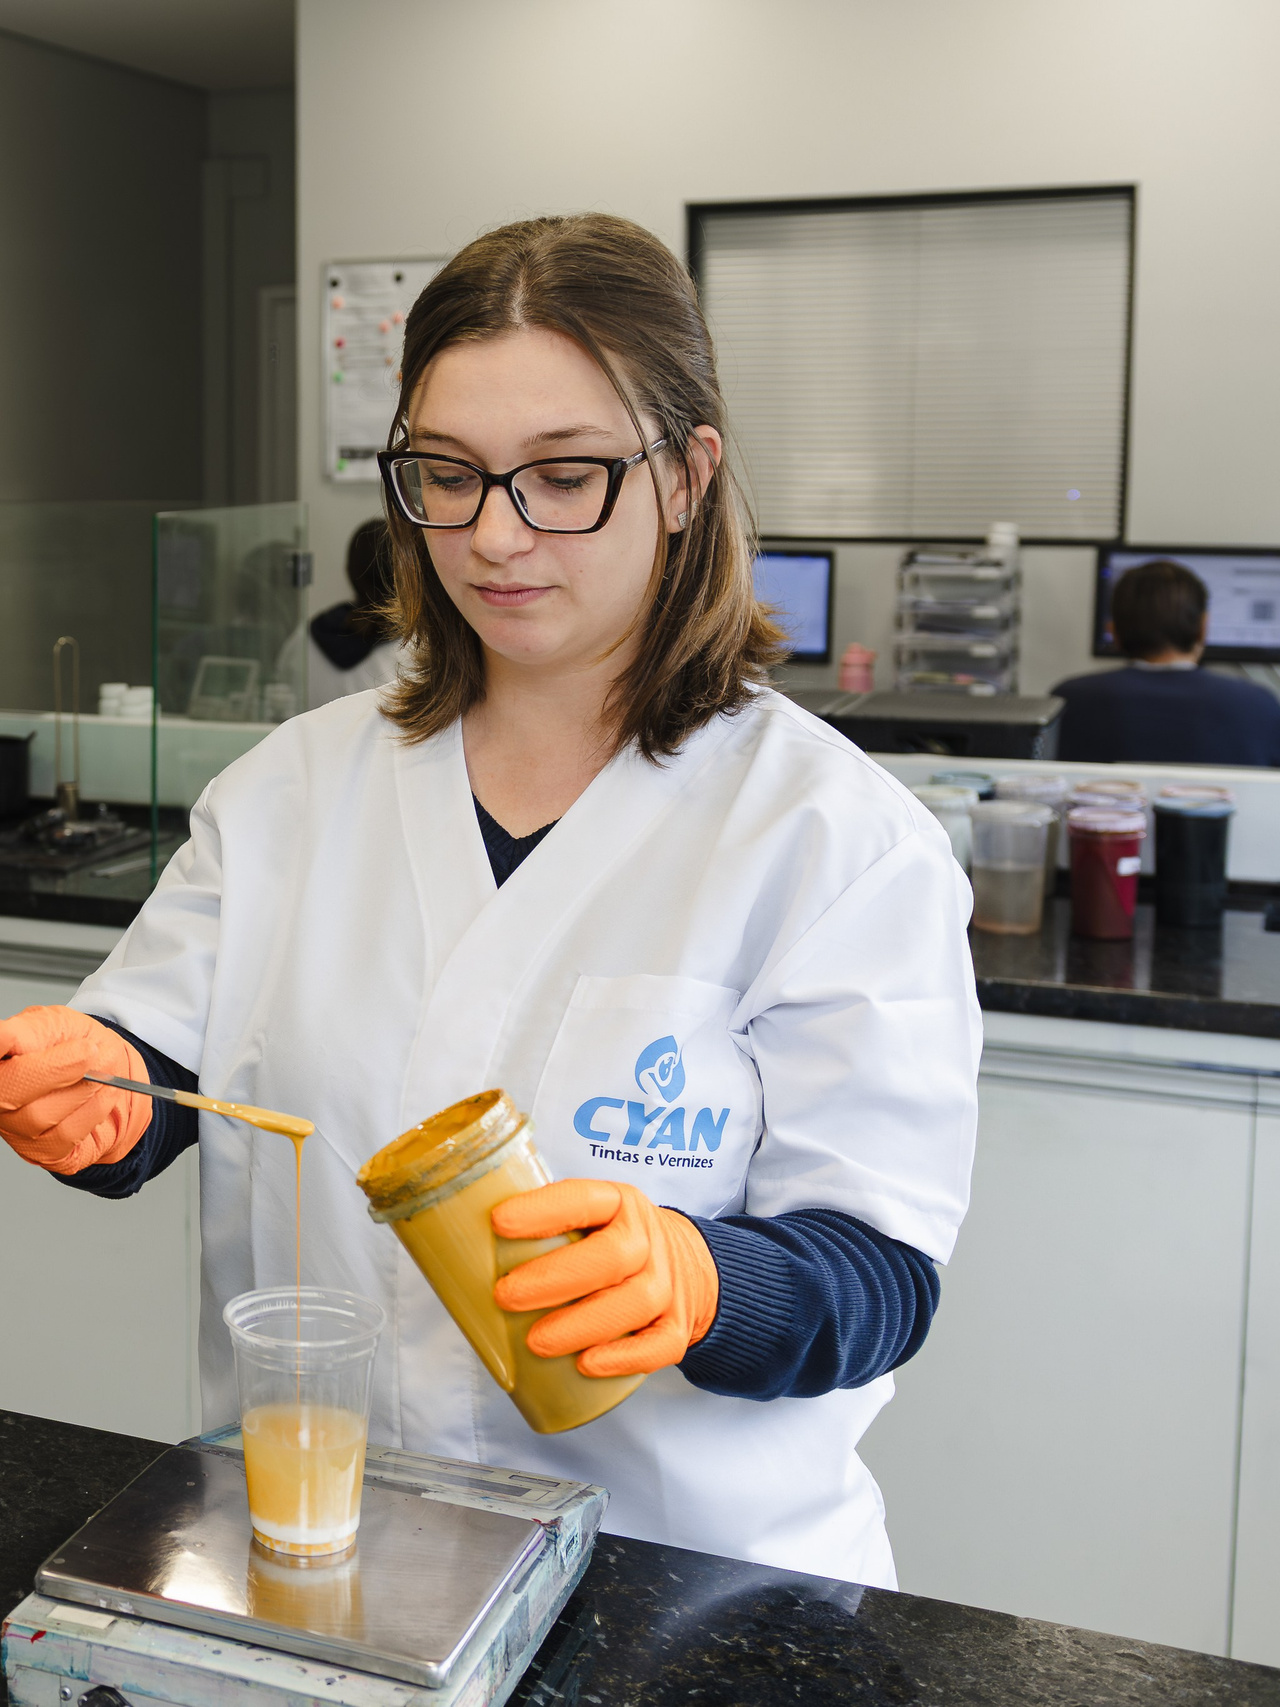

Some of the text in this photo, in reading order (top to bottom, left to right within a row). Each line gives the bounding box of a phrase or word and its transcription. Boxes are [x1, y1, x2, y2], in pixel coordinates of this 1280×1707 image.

[573, 1096, 731, 1152] CYAN
[589, 1143, 714, 1168] Tintas e Vernizes
